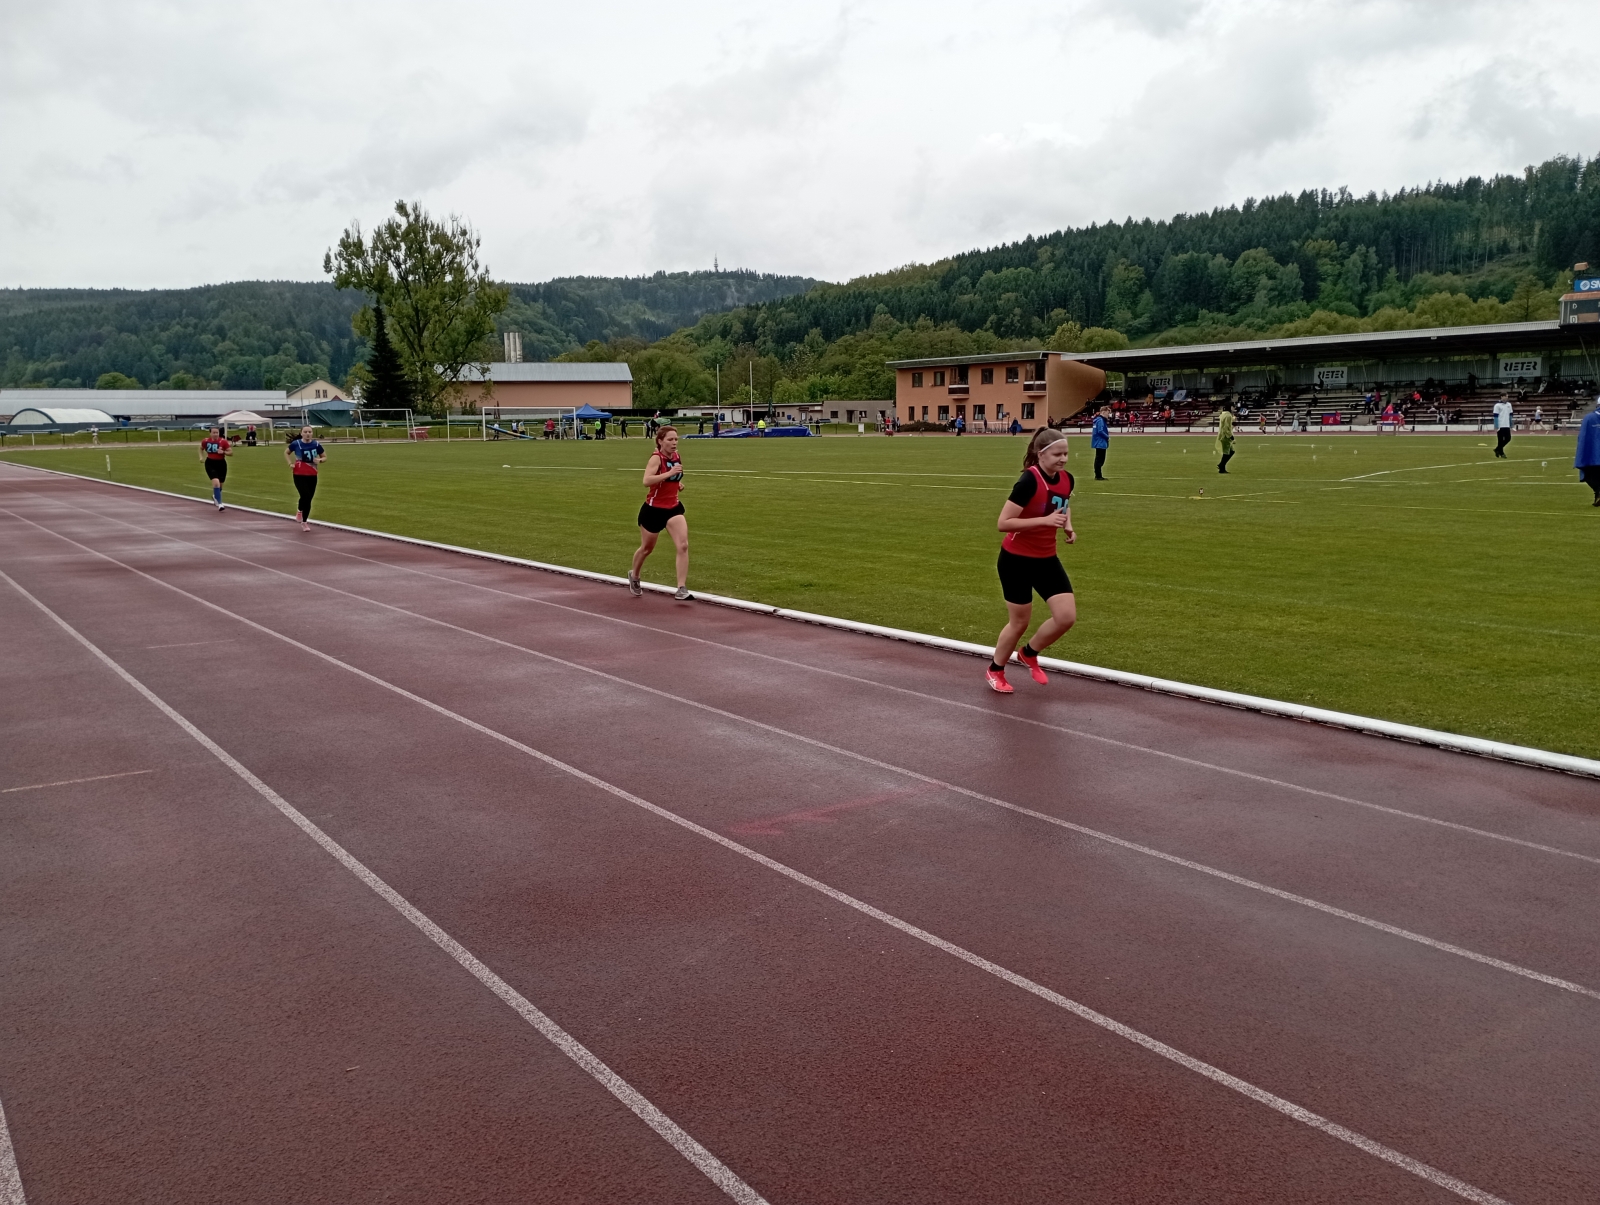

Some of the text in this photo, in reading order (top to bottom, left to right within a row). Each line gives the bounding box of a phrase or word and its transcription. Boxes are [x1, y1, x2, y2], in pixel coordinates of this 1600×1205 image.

[1503, 361, 1538, 372] RIETER
[1317, 370, 1345, 379] RIETER
[206, 442, 218, 453] 28
